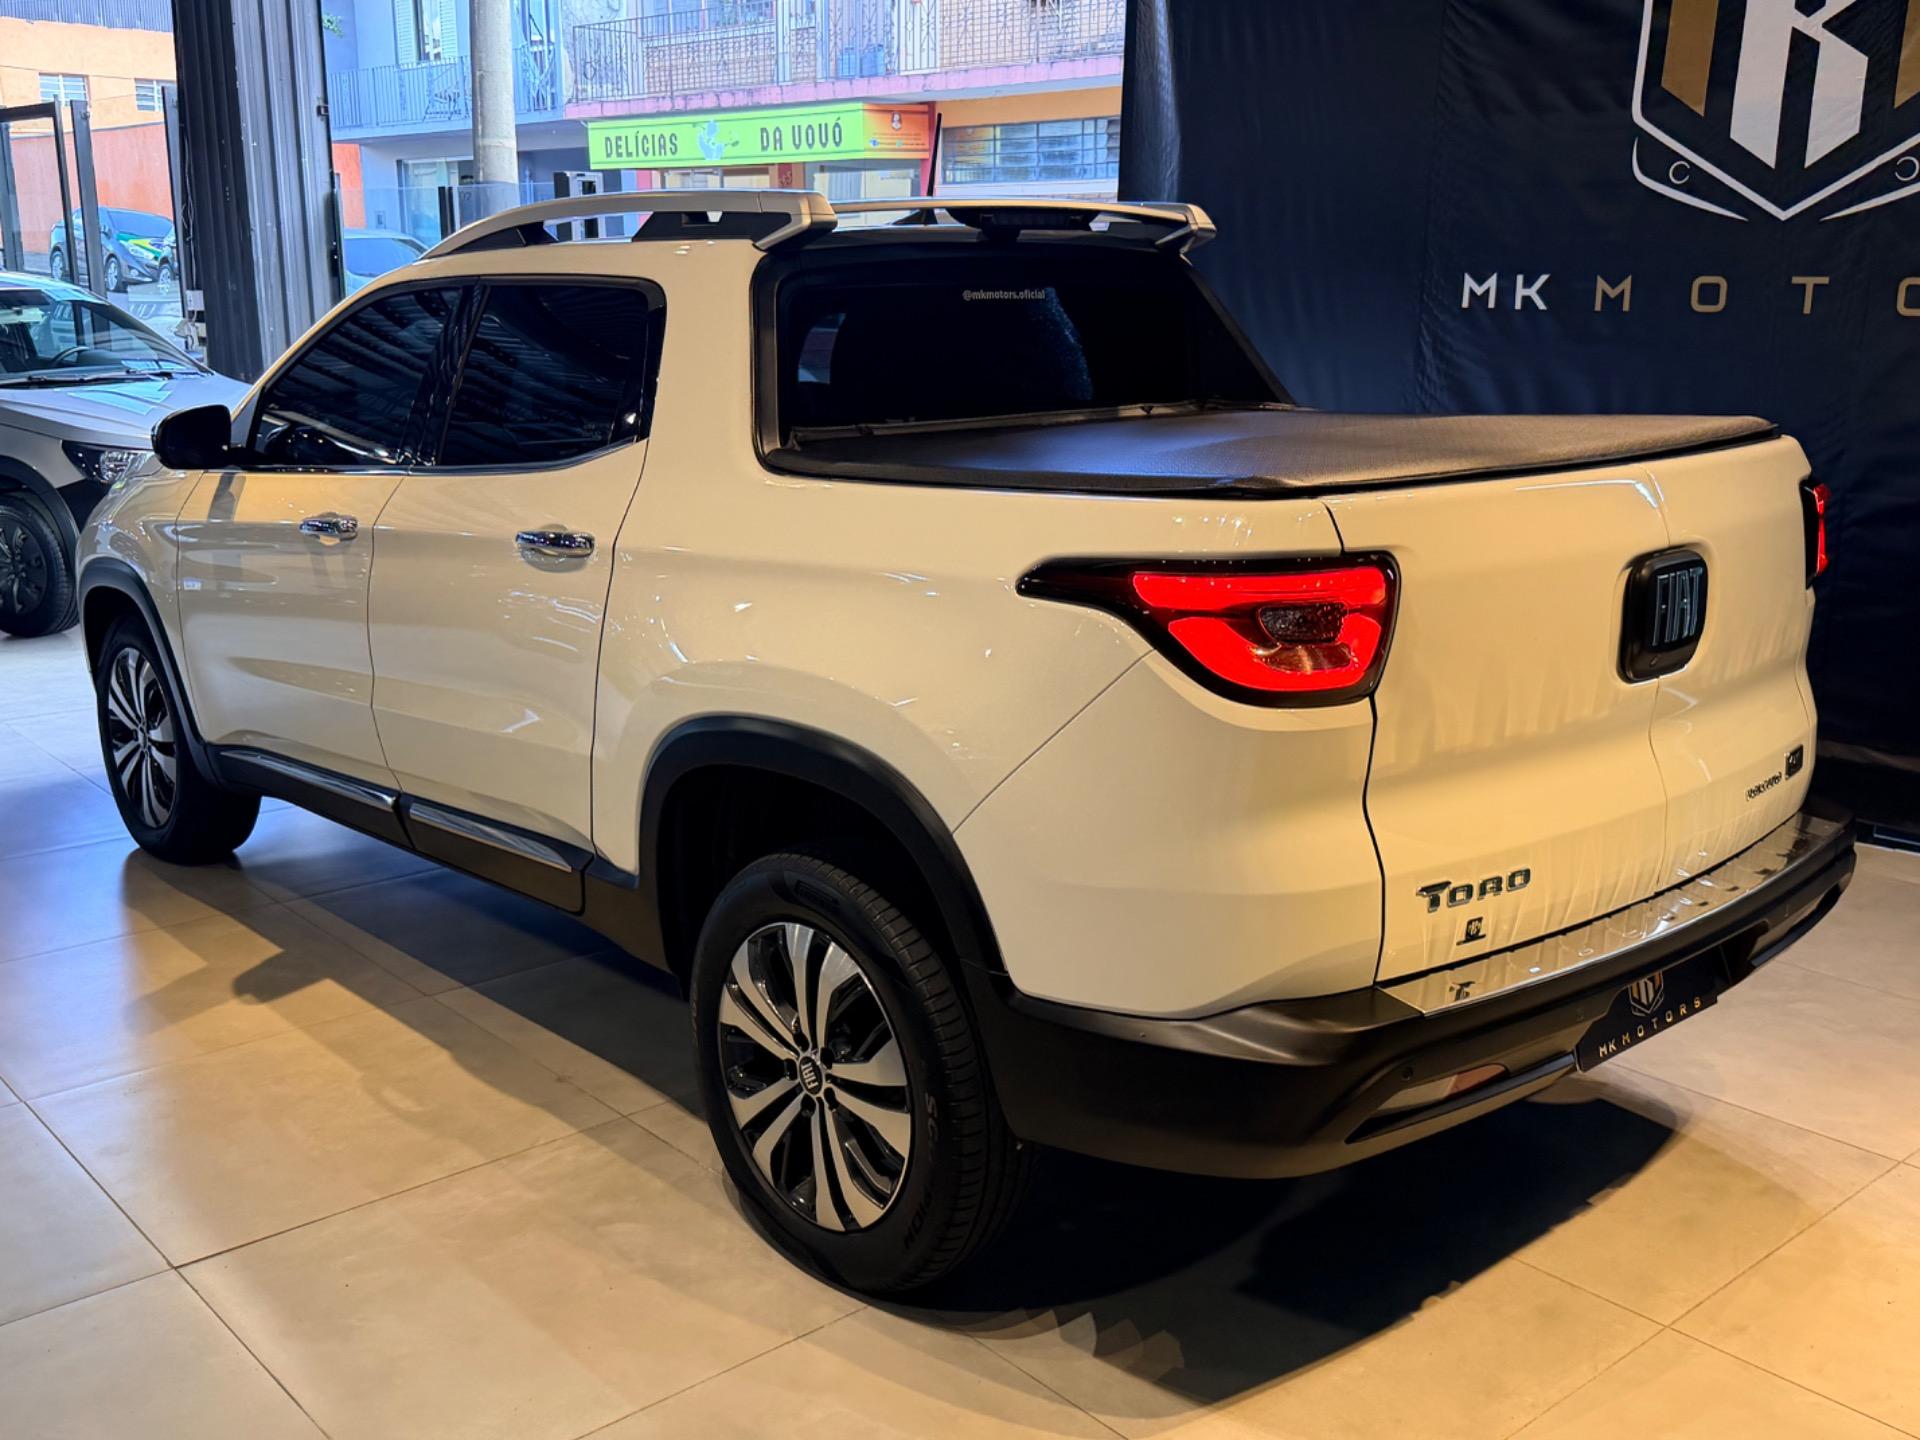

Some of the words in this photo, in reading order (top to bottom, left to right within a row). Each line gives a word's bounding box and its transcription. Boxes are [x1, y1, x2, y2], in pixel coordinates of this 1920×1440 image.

[605, 130, 678, 158] DELÍCIAS
[760, 126, 783, 152] DA
[1461, 272, 1550, 310] MK
[1652, 566, 1704, 647] FIAT
[1415, 868, 1531, 914] TORO
